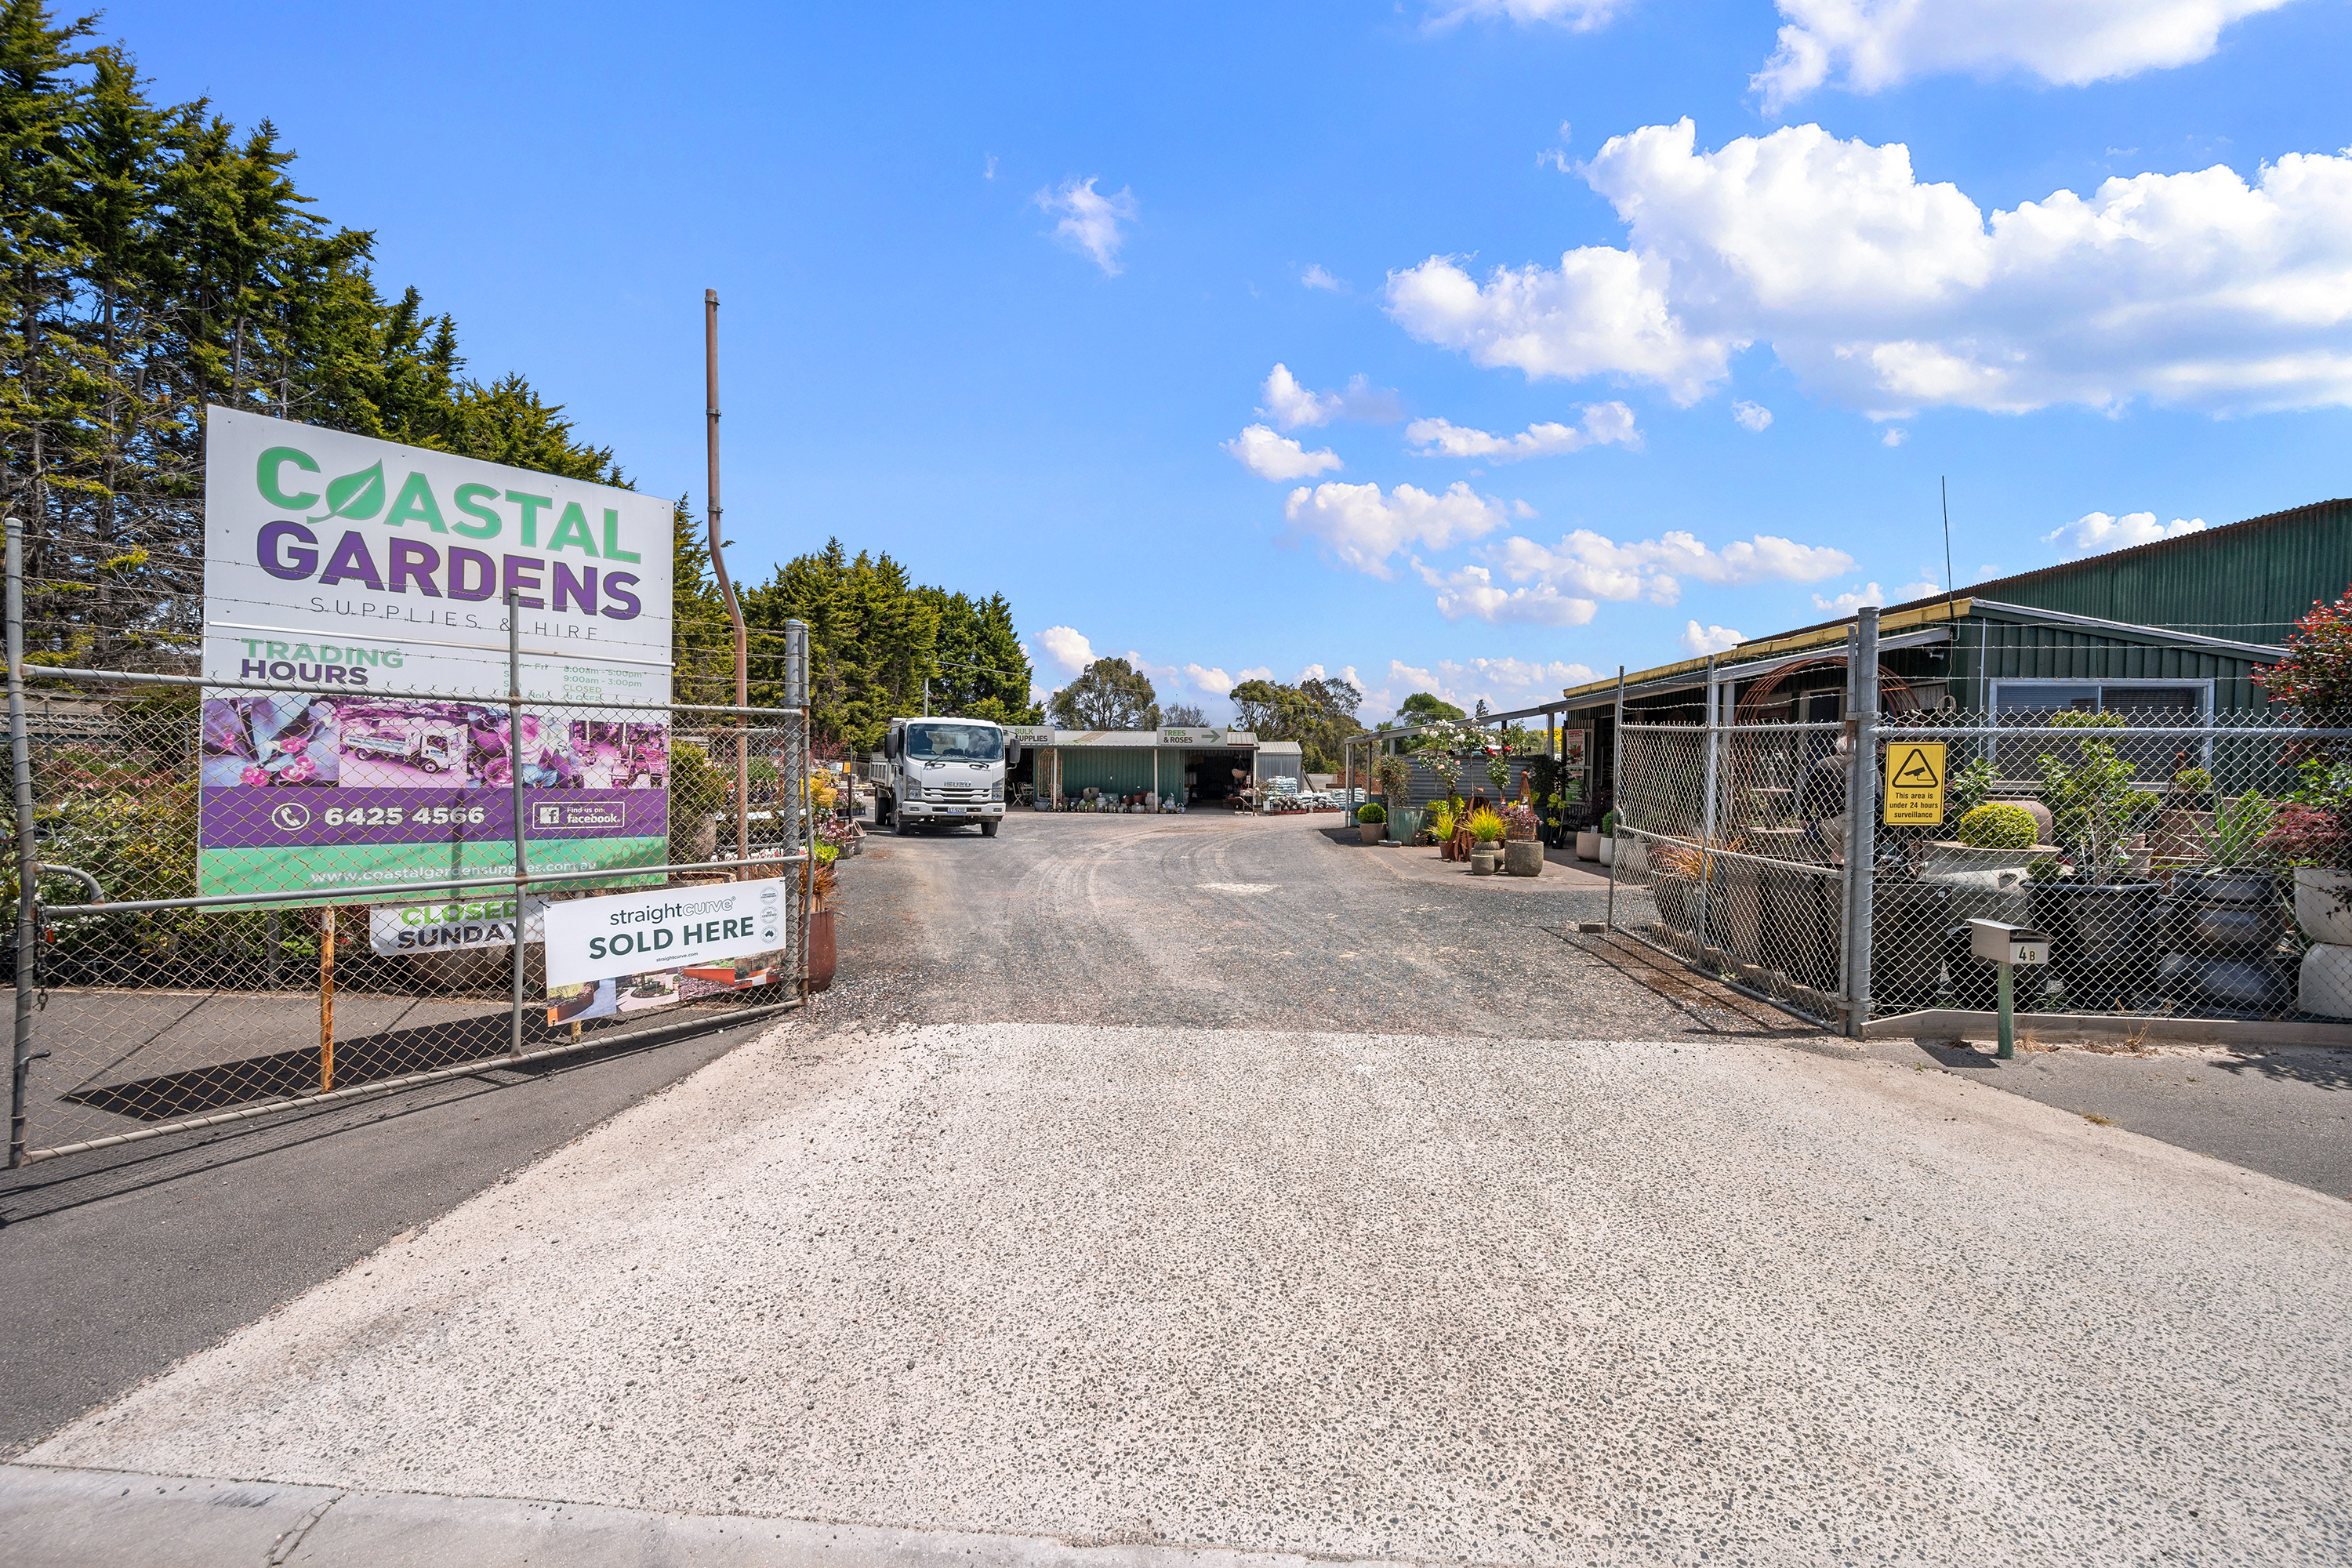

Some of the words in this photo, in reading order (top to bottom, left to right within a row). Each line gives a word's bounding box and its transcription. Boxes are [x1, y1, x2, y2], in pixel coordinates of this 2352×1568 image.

[256, 520, 643, 621] GARDENS
[310, 597, 479, 629] SUPPLIES
[240, 637, 404, 669] TRADING
[241, 659, 368, 685] HOURS
[564, 675, 599, 684] 9:00am
[608, 678, 642, 688] 3:00pm
[563, 684, 602, 693] CLOSED
[324, 807, 404, 826] 6425
[412, 806, 485, 825] 4566
[401, 901, 517, 926] CLOSED
[589, 928, 673, 960] SOLD
[684, 916, 754, 946] HERE
[656, 952, 699, 962] straightcurve.com
